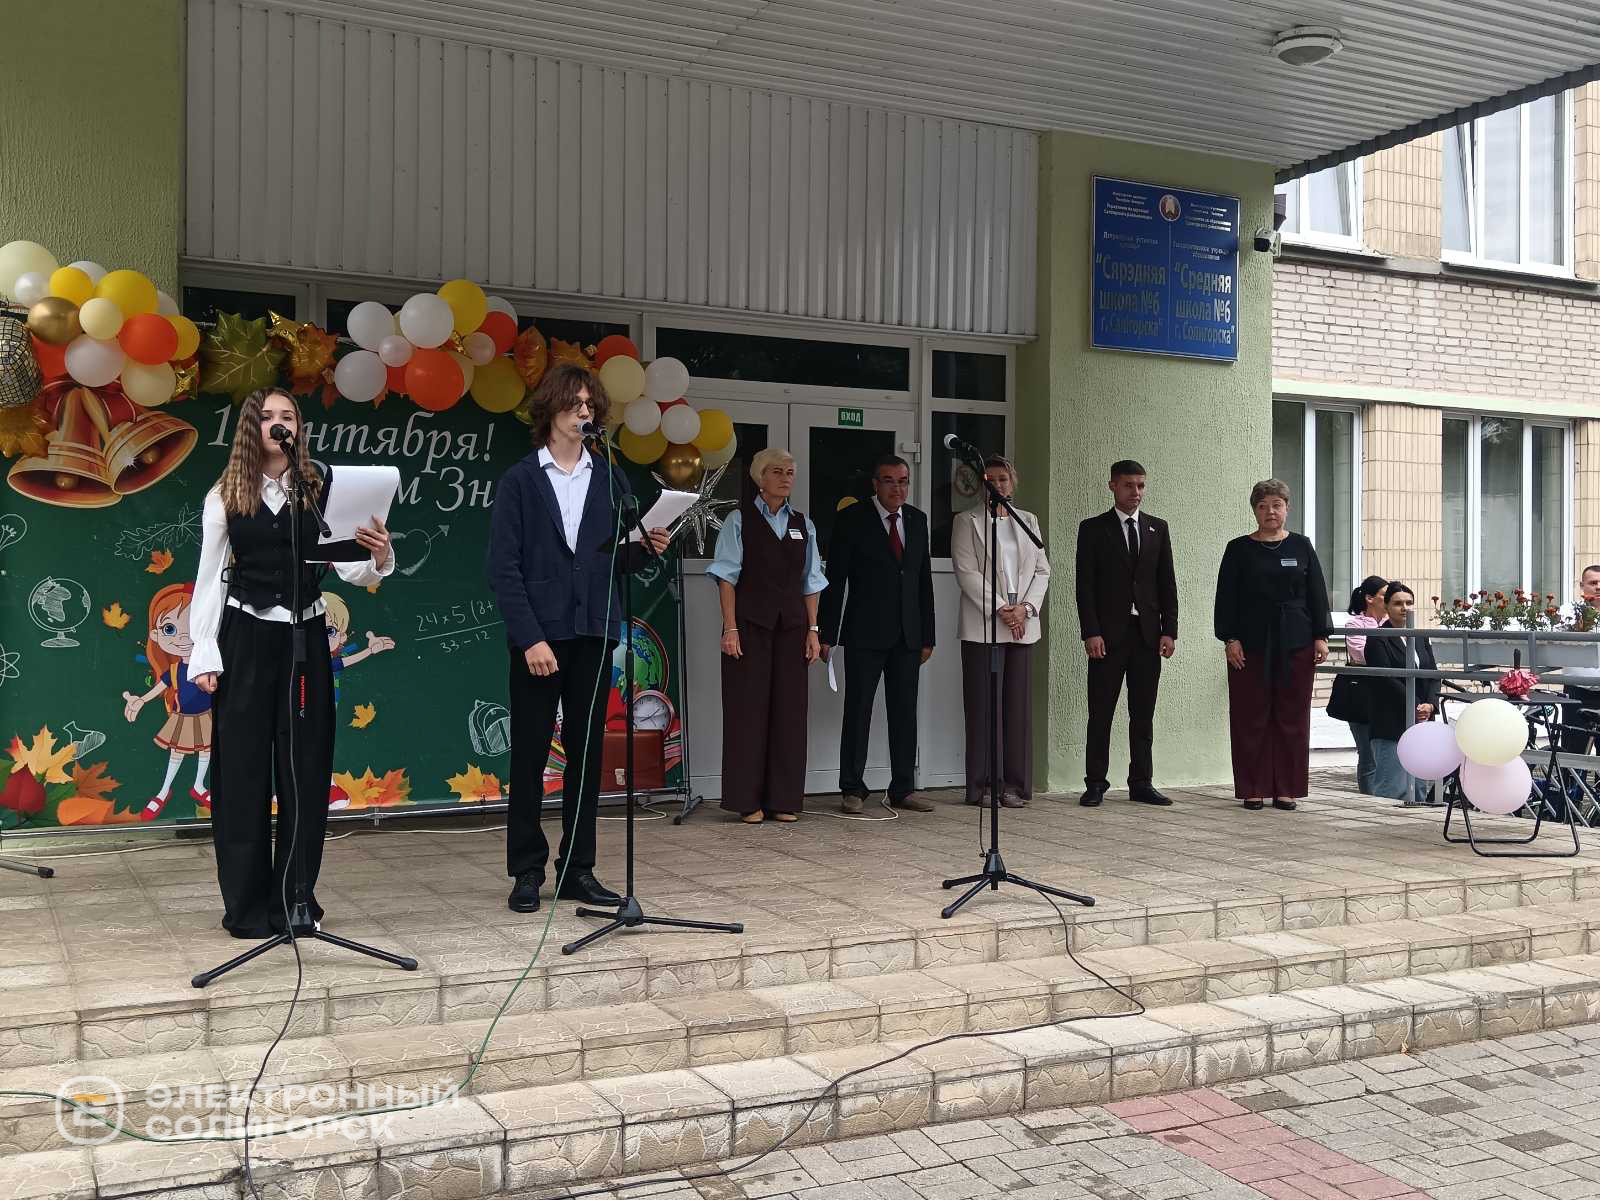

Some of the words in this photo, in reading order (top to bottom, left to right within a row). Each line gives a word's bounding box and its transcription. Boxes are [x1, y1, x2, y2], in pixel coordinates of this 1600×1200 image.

[1175, 299, 1212, 322] школа
[1213, 298, 1231, 324] №6
[840, 411, 861, 423] ВХОД
[207, 404, 232, 447] 1
[302, 411, 496, 474] нтября!
